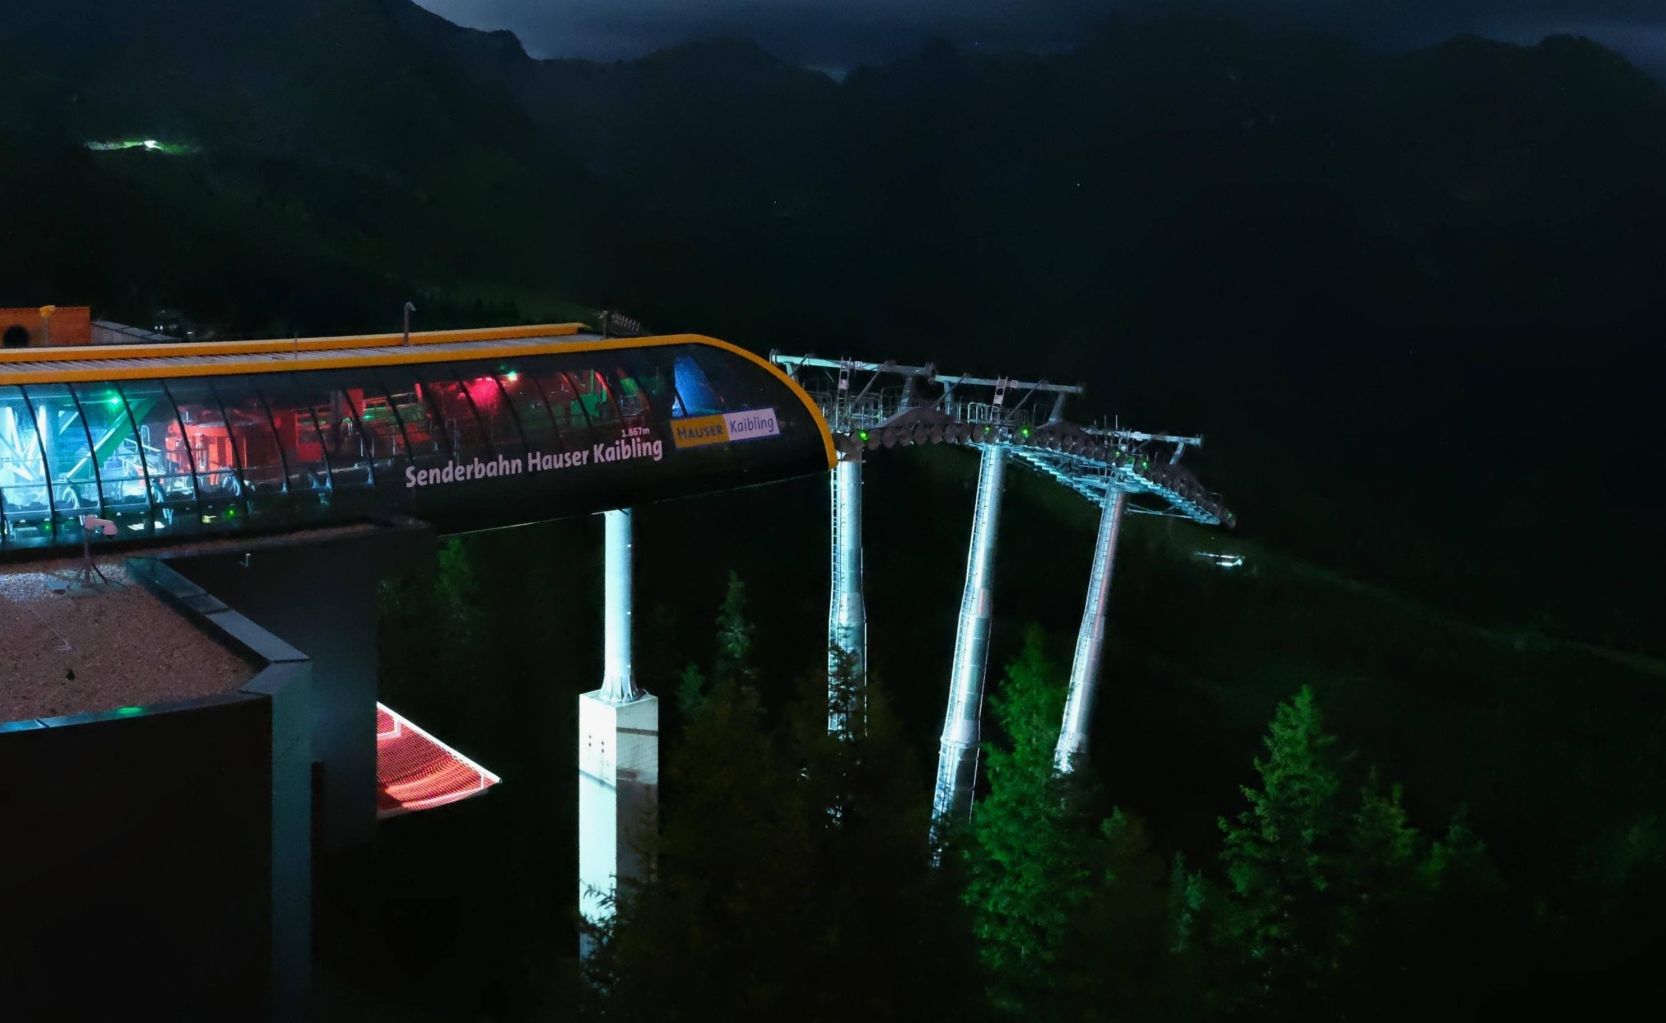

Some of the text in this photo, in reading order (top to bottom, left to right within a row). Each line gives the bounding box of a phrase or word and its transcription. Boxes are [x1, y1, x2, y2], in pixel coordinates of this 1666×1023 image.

[621, 427, 650, 438] 1.867m
[677, 416, 774, 440] HAUSER Kaibling
[405, 437, 663, 488] Senderbahn Hauser Kaibling
